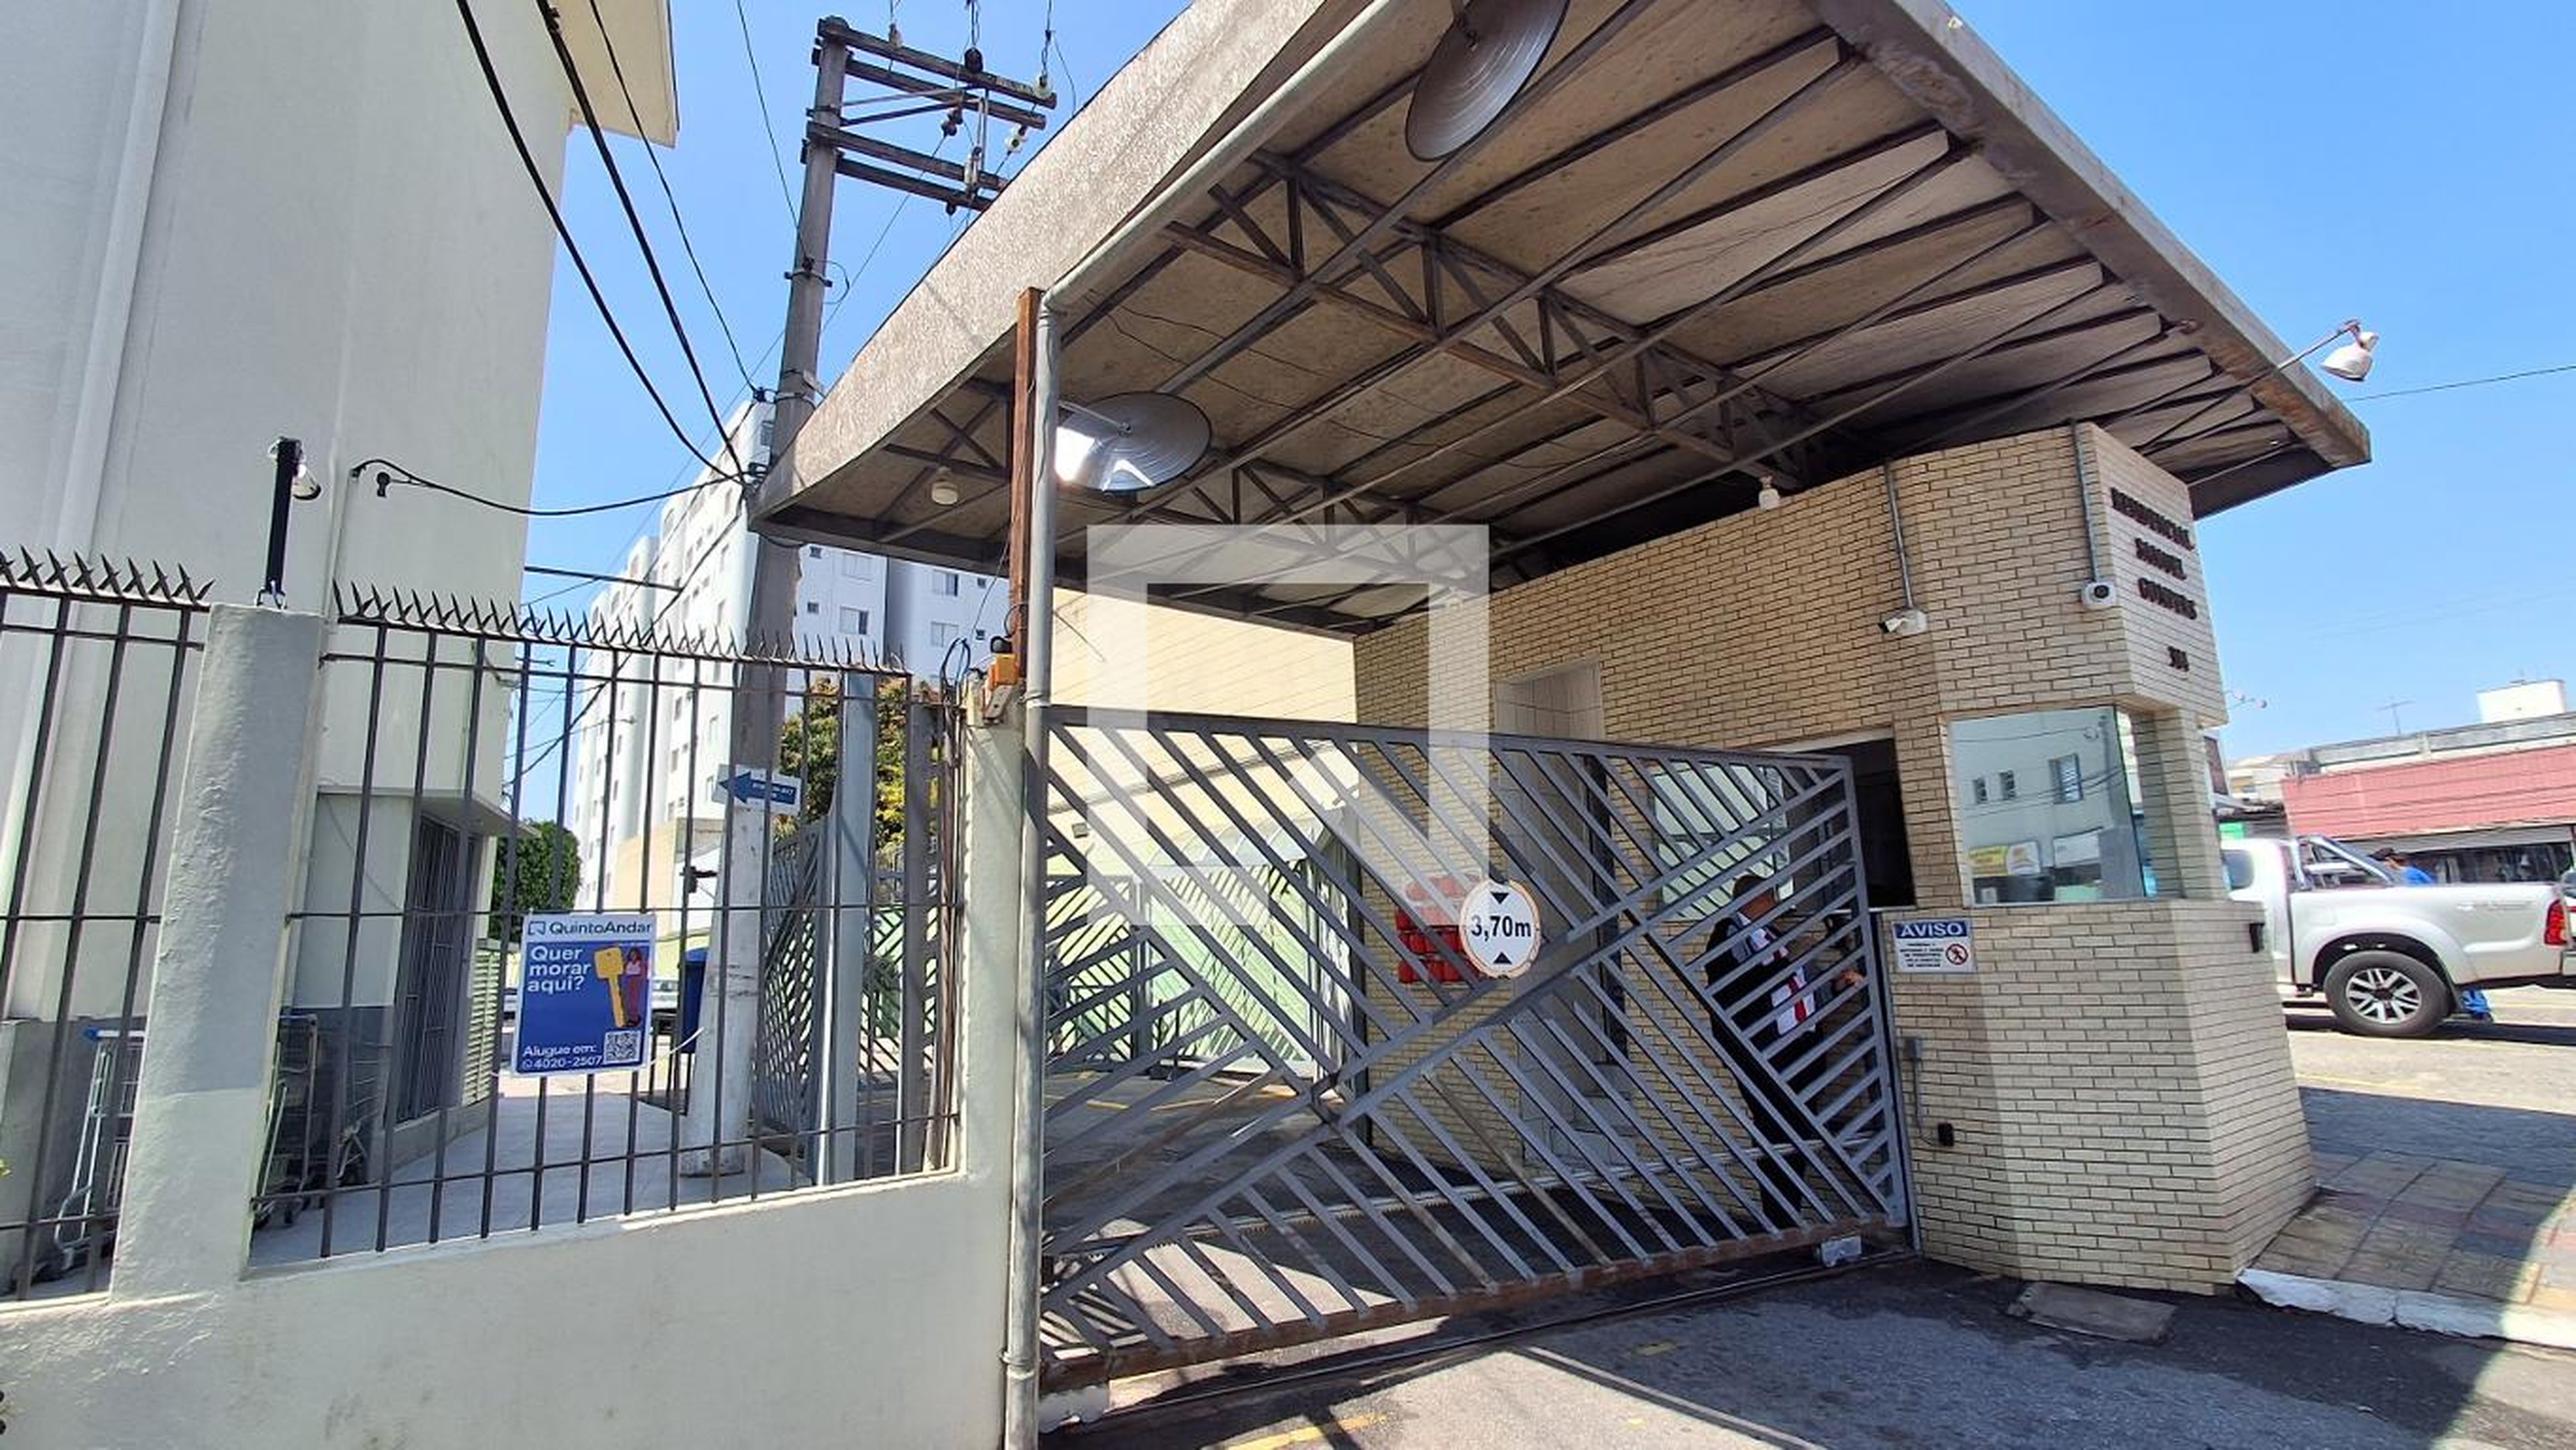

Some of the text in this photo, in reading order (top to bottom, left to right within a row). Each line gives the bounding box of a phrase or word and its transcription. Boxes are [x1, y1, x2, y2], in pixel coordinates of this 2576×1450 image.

[549, 921, 651, 935] QuintoAndar
[1471, 915, 1532, 941] 3,70m
[1900, 922, 1963, 937] AVISO
[531, 945, 583, 961] Quer
[530, 964, 592, 976] morar
[527, 975, 584, 994] aqui?
[523, 1045, 570, 1058] Alugue
